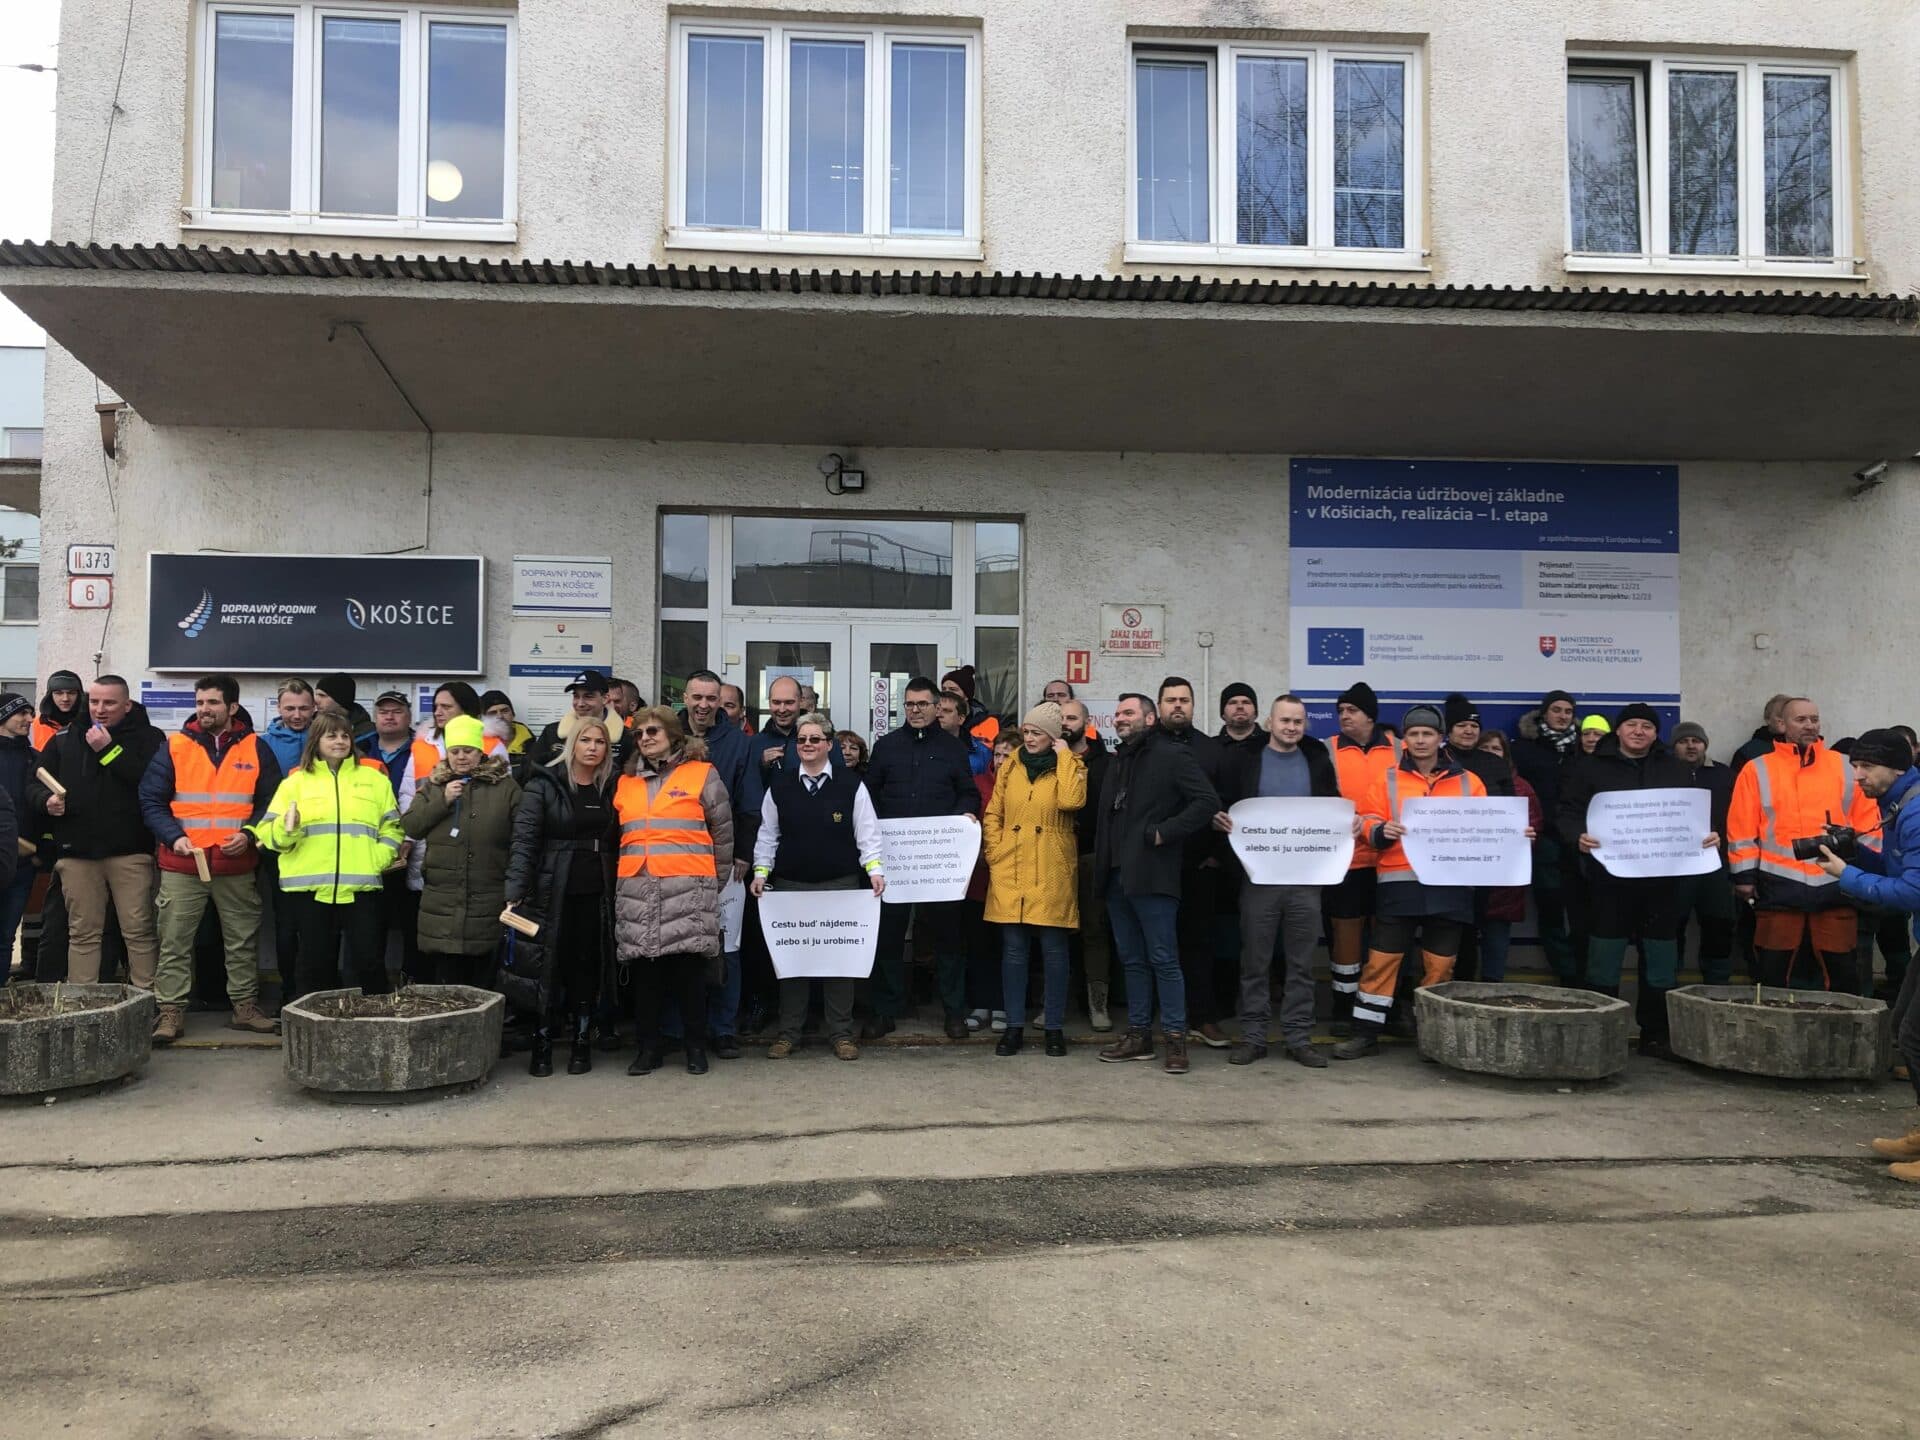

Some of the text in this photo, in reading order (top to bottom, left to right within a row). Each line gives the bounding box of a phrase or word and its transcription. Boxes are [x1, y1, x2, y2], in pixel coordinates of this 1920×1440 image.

[1307, 485, 1565, 504] Modernizácia údržbovej základne
[1307, 508, 1317, 519] v
[1320, 505, 1397, 522] Košiciach,
[1401, 506, 1473, 521] realizácia
[1504, 509, 1548, 525] etapa
[75, 551, 110, 568] II.373
[521, 568, 603, 579] DOPRAVNÝ PODNIK
[532, 580, 595, 589] MESTA KOŠICE
[86, 584, 95, 601] 6
[221, 602, 317, 614] DOPRAVNÝ PODNIK
[370, 600, 455, 625] KOŠICE
[220, 613, 294, 625] MESTA KOŠICE
[1560, 647, 1595, 655] DOPRAVY
[1560, 655, 1604, 663] SLOVENSKEJ
[1307, 711, 1333, 720] Projekt
[907, 827, 932, 837] doprava
[933, 828, 940, 836] je
[1242, 826, 1267, 834] Cestu
[1270, 826, 1288, 834] buď
[1291, 826, 1331, 836] nájdeme
[1245, 844, 1270, 852] alebo
[1283, 844, 1291, 853] ju
[771, 920, 796, 929] Cestu
[799, 919, 818, 928] buď
[820, 919, 858, 929] nájdeme
[775, 938, 800, 946] alebo
[812, 938, 820, 947] ju
